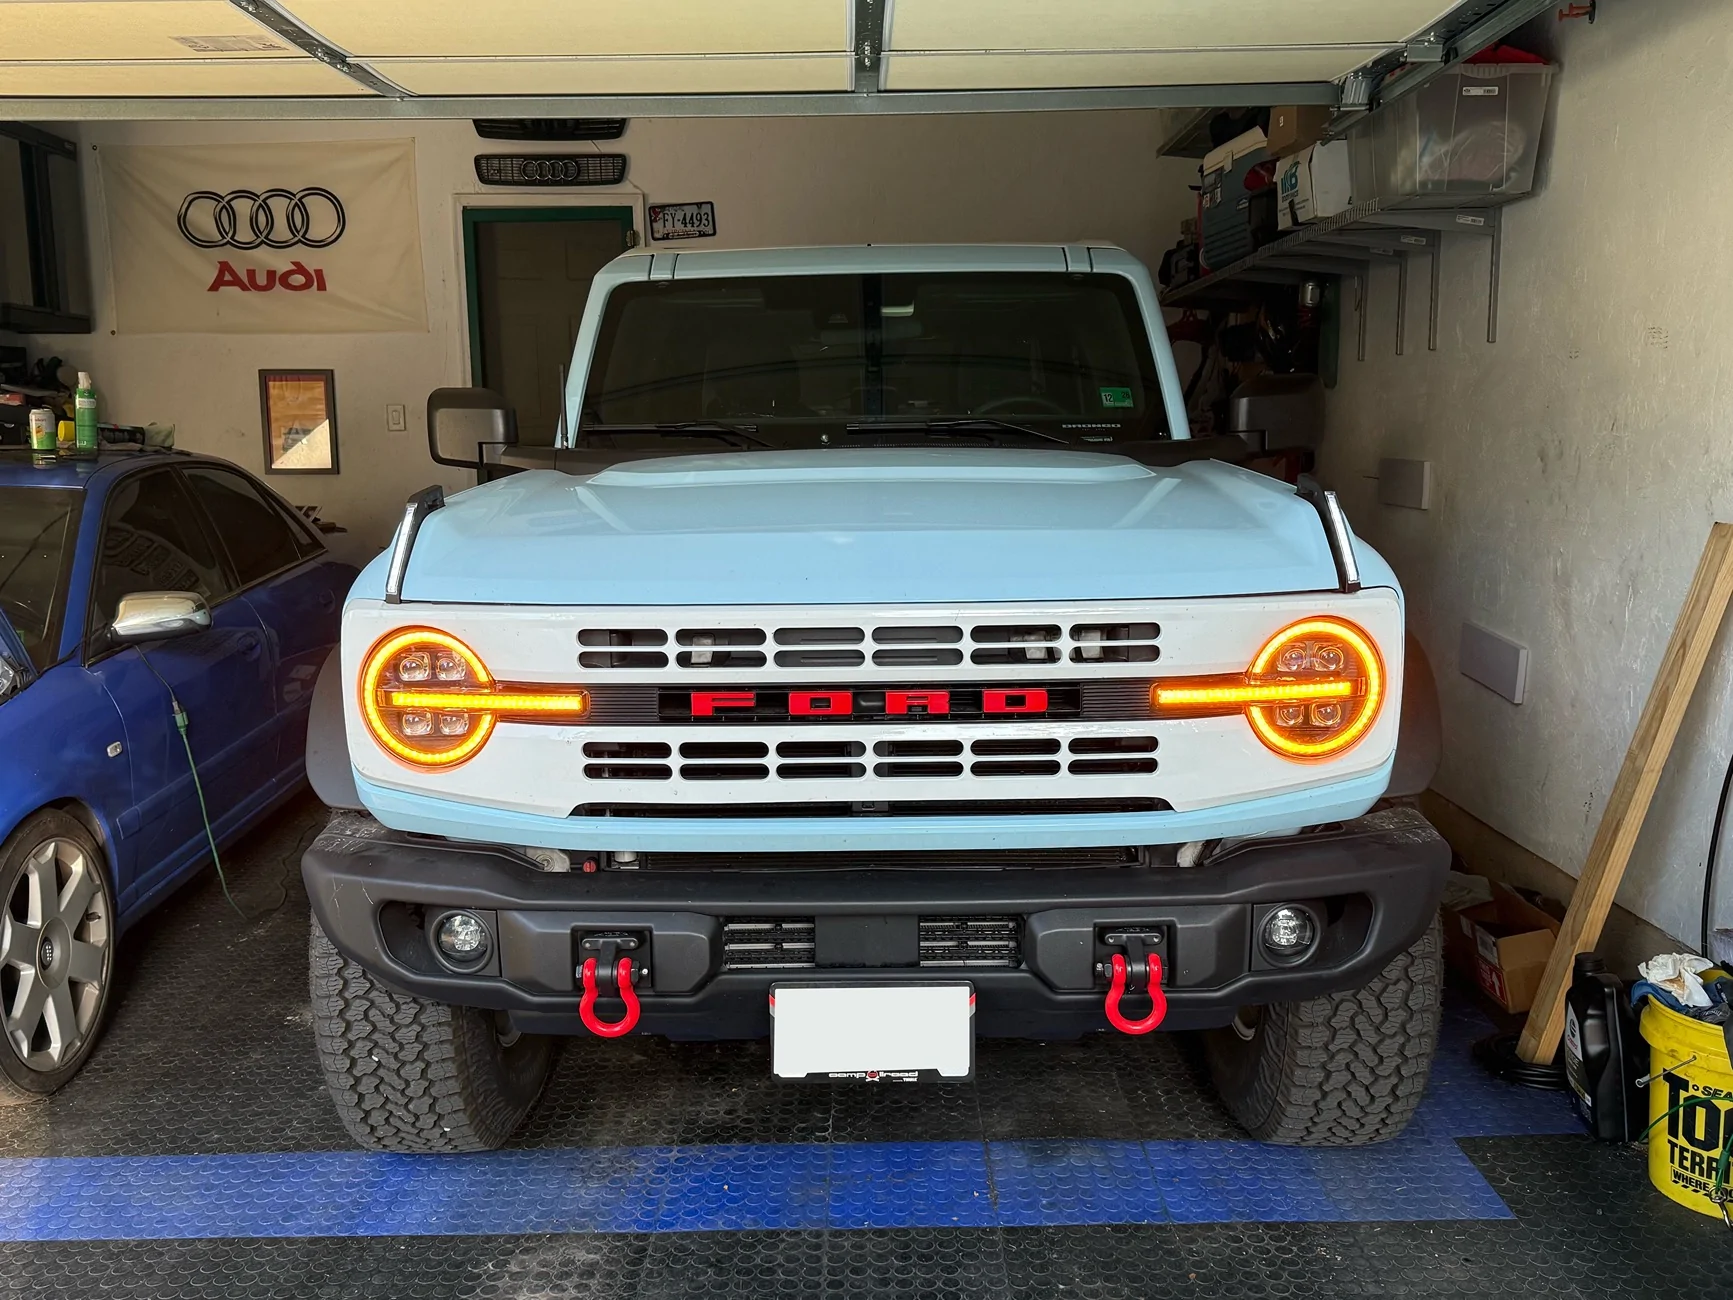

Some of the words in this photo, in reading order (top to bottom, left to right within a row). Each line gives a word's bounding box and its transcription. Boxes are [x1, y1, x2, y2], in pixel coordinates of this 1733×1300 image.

[662, 212, 711, 228] FY-4493
[207, 261, 327, 292] Audi
[1103, 393, 1113, 403] 12
[691, 690, 1049, 716] FORD
[1662, 1067, 1733, 1154] TO
[1672, 1168, 1710, 1193] WHERE
